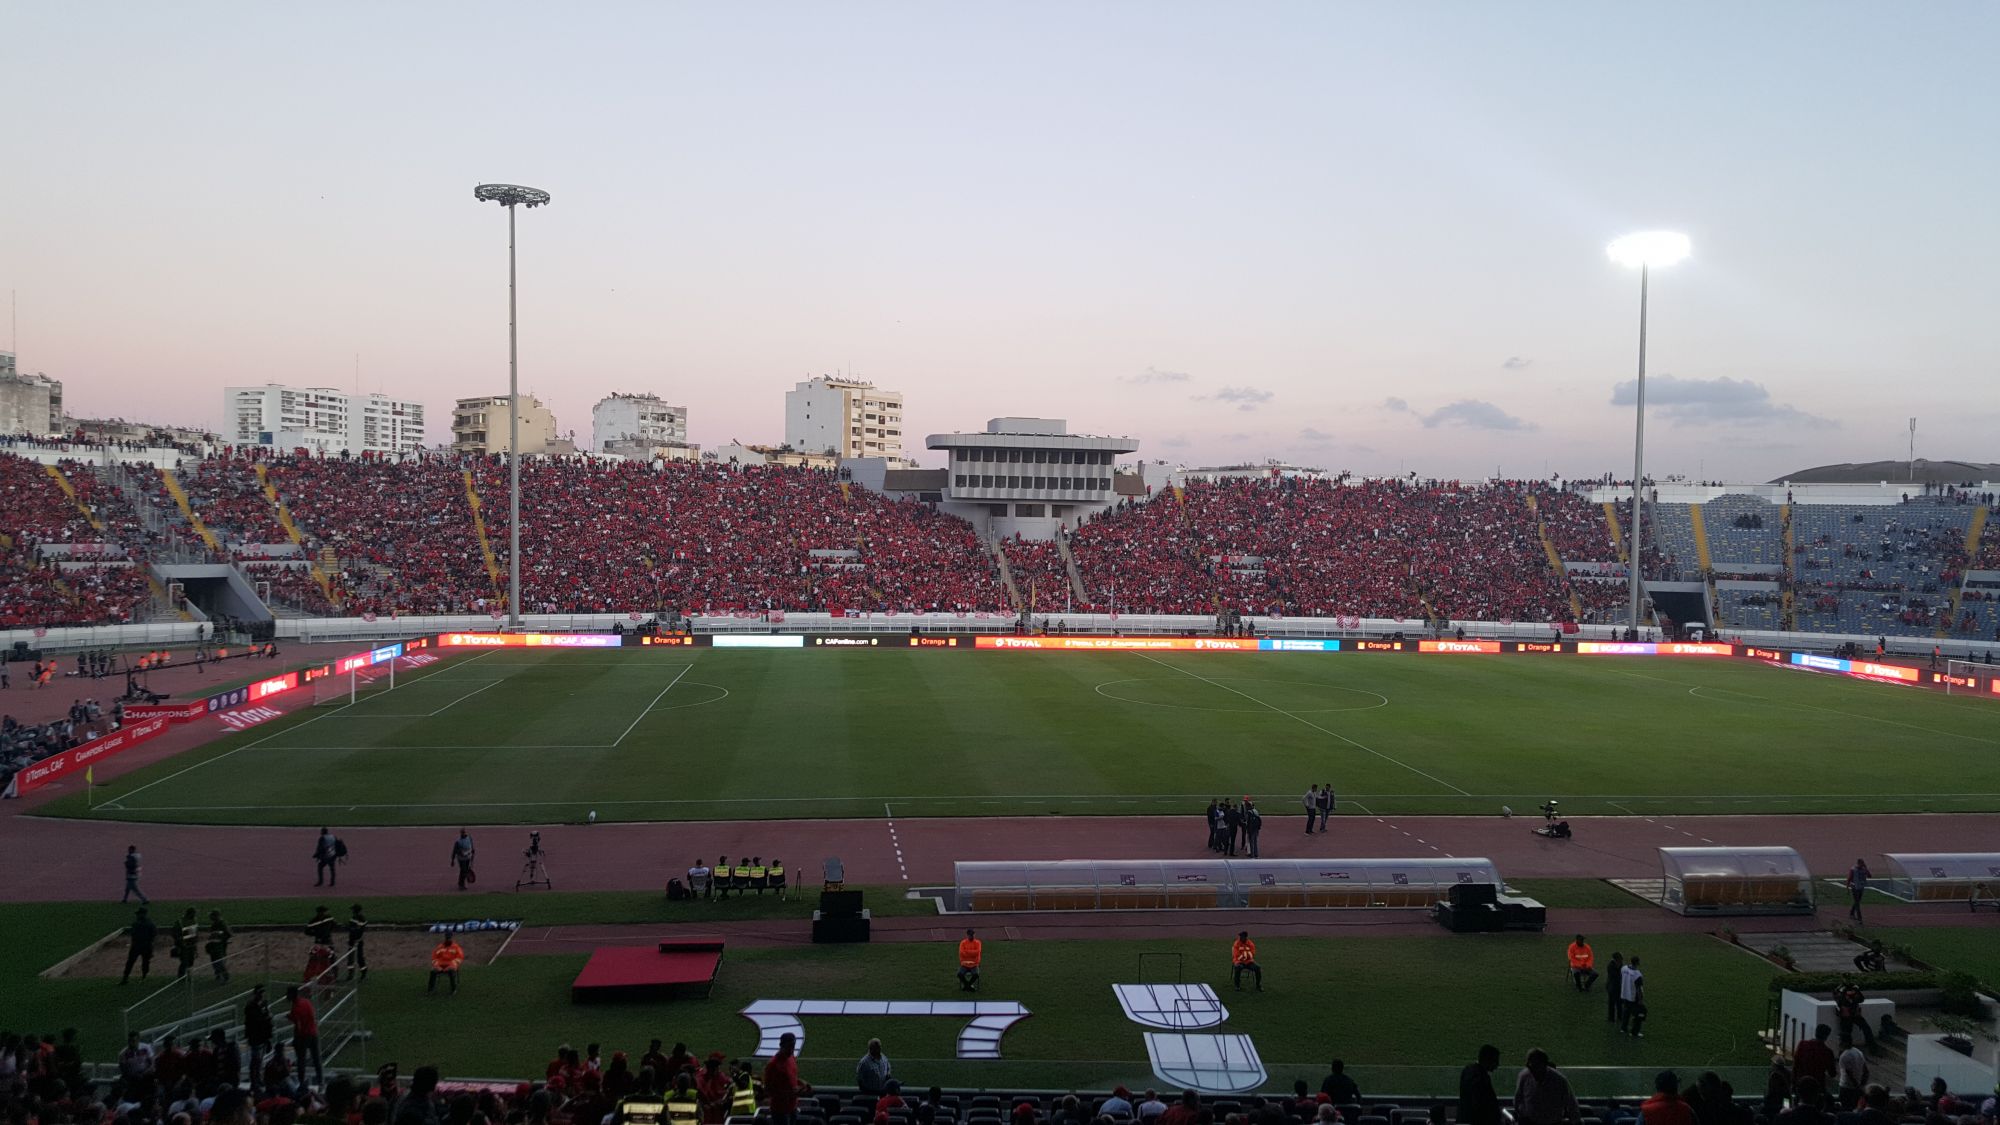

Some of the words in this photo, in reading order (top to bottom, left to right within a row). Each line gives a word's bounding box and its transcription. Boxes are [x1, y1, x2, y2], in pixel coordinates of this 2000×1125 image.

[464, 635, 504, 645] TOTAL
[654, 636, 681, 645] Orange
[921, 638, 946, 646] Orange
[1006, 638, 1041, 647] TOTAL
[1206, 640, 1240, 649] TOTAL
[1368, 642, 1391, 650] Orange
[1449, 642, 1482, 651] TOTAL
[1528, 644, 1551, 652] Orange
[1683, 645, 1716, 653] TOTAL
[1756, 649, 1773, 658] Orange
[1872, 664, 1902, 677] TOTAL
[123, 710, 189, 719] CHAMPONS
[30, 766, 50, 781] TOTAL
[50, 758, 65, 773] CAF
